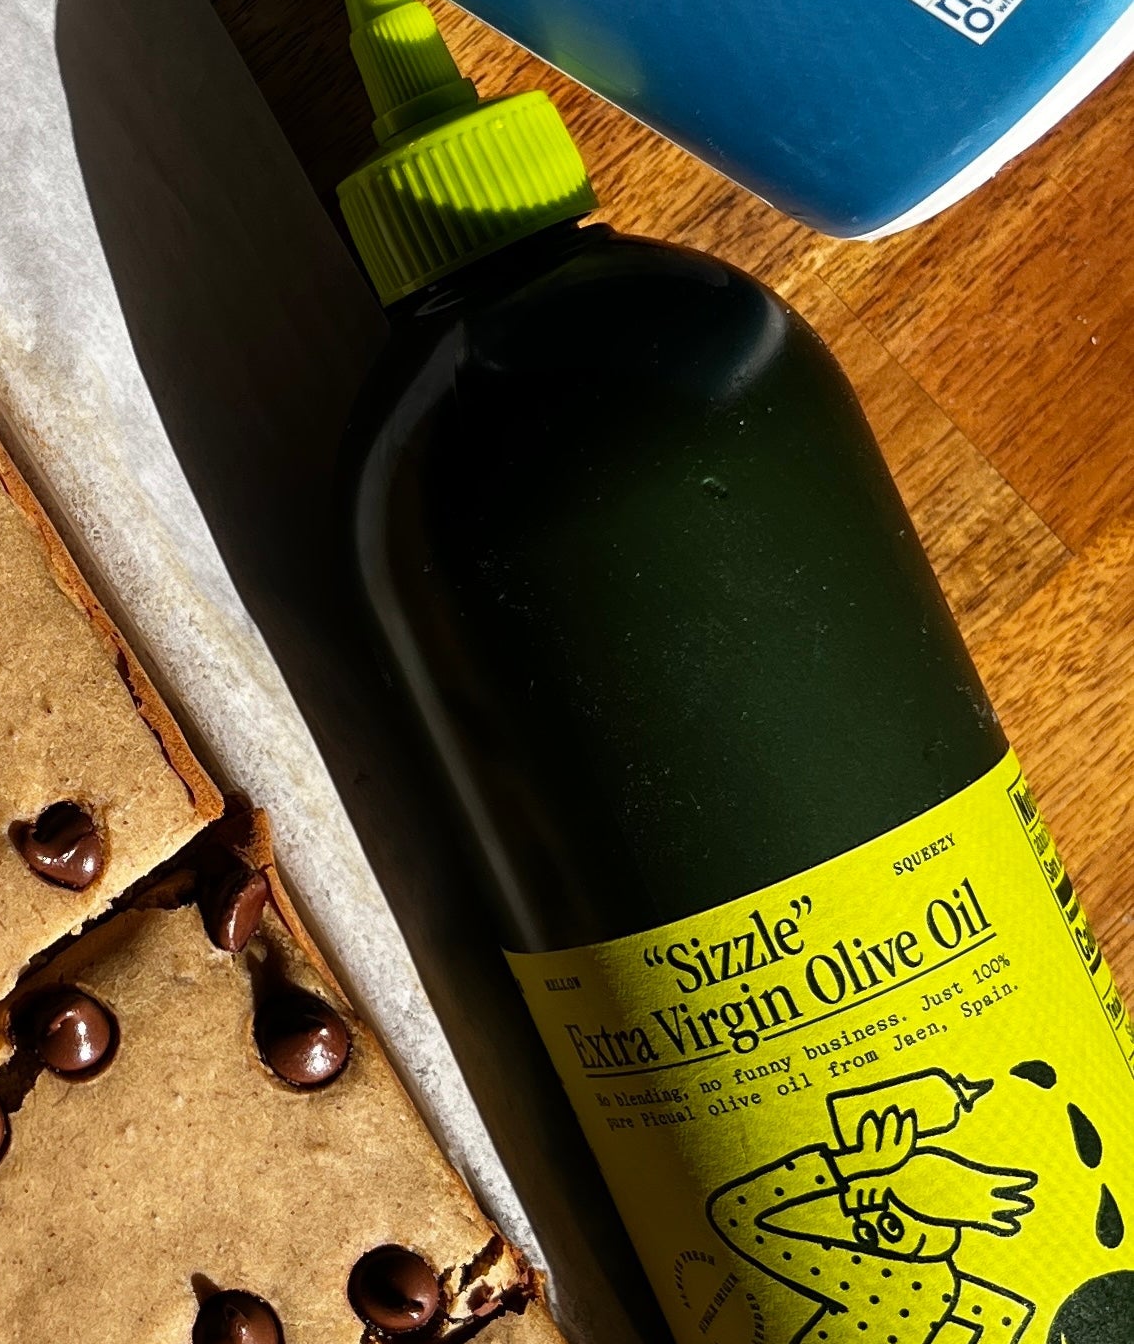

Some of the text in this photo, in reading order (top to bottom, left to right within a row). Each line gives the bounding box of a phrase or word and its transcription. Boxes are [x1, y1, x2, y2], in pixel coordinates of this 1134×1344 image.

[892, 832, 956, 876] SQUEEZY
[564, 1023, 659, 1070] Extra
[650, 983, 804, 1057] Virgin
[804, 937, 924, 1005] Olive
[926, 877, 992, 949] Oil
[614, 1086, 690, 1108] blending,
[699, 1078, 722, 1095] no
[733, 1055, 792, 1086] funny
[802, 1010, 908, 1061] business.
[921, 981, 964, 1012] Just
[972, 952, 1012, 985] 100%
[640, 1107, 696, 1127] Picual
[708, 1090, 762, 1116] olive
[777, 1072, 813, 1097] oil
[827, 1049, 880, 1078] from
[893, 1023, 948, 1052] Jaen,
[960, 983, 1019, 1018] Spain.
